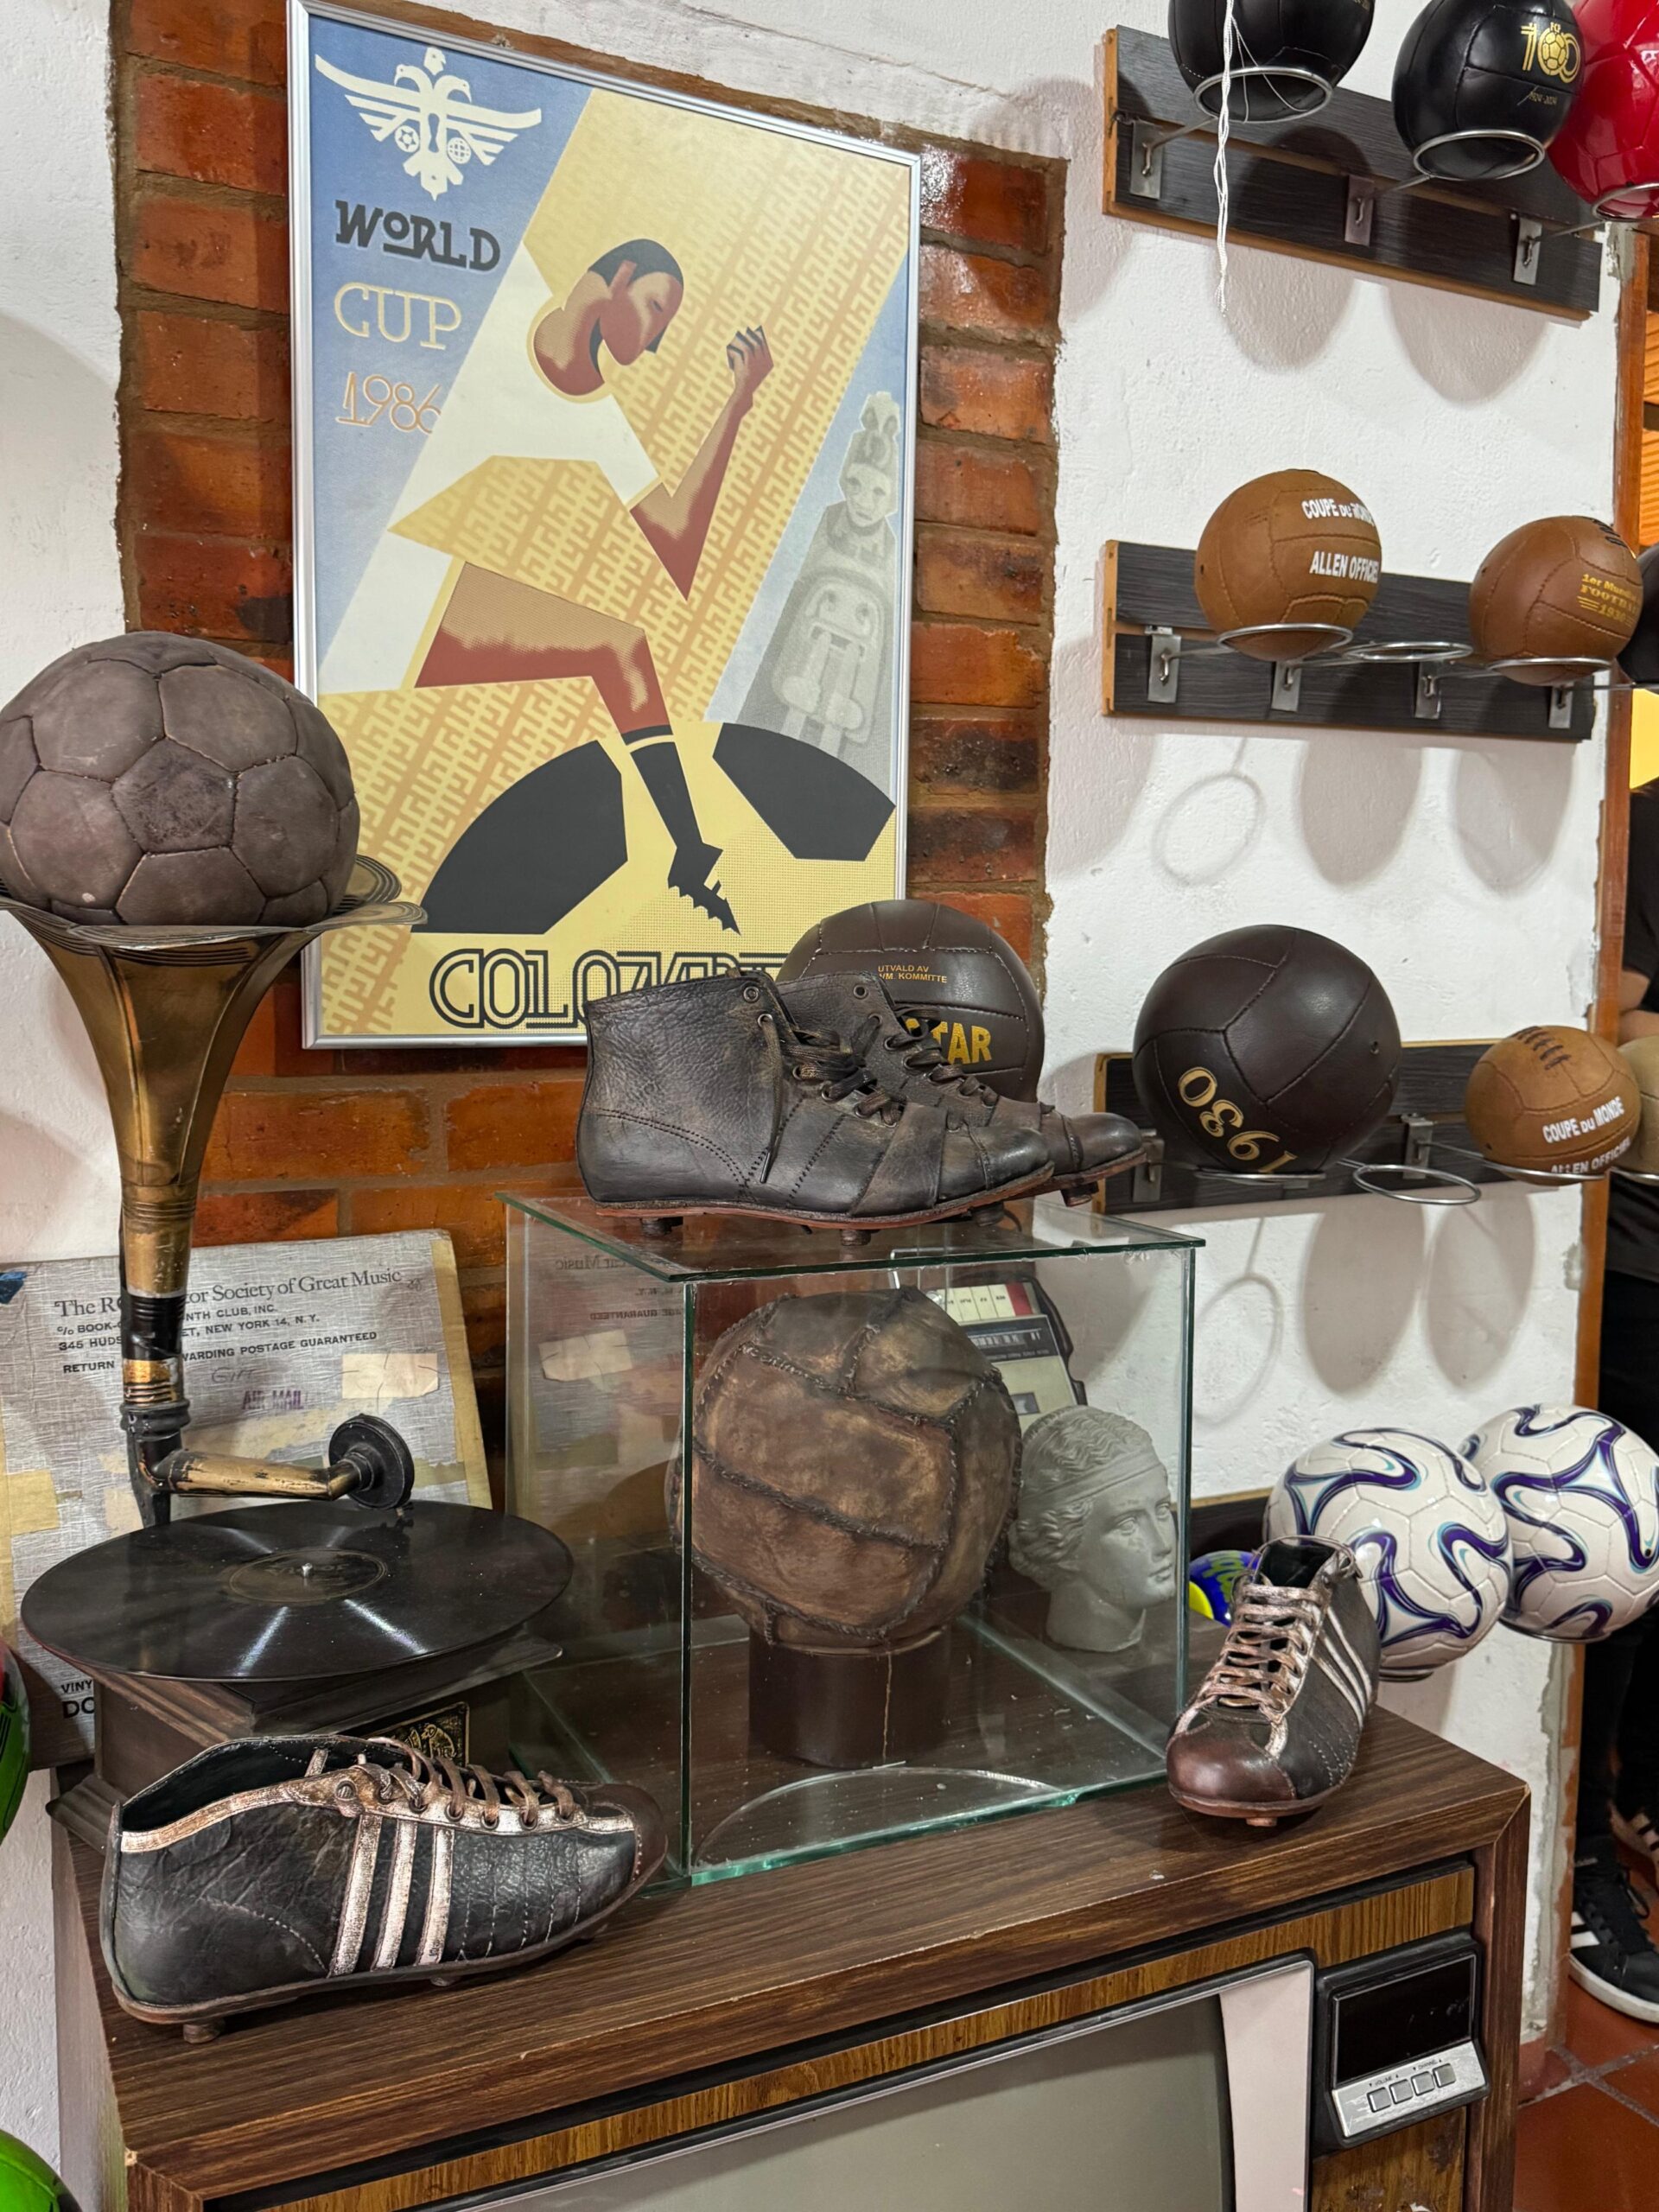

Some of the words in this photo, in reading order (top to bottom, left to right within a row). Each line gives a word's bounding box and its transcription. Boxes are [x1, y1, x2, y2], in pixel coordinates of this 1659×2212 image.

[335, 200, 501, 272] WORLD
[334, 282, 461, 351] CUP
[336, 372, 442, 434] 1986
[1301, 499, 1339, 519] COUPE
[1309, 551, 1348, 577] ALLEN
[899, 973, 947, 983] KOMMITTE
[1179, 1066, 1298, 1173] 1930
[1542, 1117, 1581, 1143] COUPE
[1592, 1096, 1624, 1127] MONDE
[54, 1298, 96, 1317] The
[213, 1284, 275, 1301] Society
[277, 1278, 296, 1294] of
[298, 1275, 347, 1293] Great
[352, 1268, 402, 1287] Music
[217, 1306, 251, 1319] CLUB,
[254, 1304, 277, 1315] INC.
[59, 1339, 84, 1351] 345
[90, 1336, 122, 1348] HUDS
[206, 1323, 232, 1334] NEW
[238, 1319, 270, 1331] YORK
[63, 1361, 115, 1374] RETURN
[240, 1340, 296, 1355] POSTAGE
[300, 1331, 377, 1348] GUARANTEED
[61, 1680, 92, 1694] VINY
